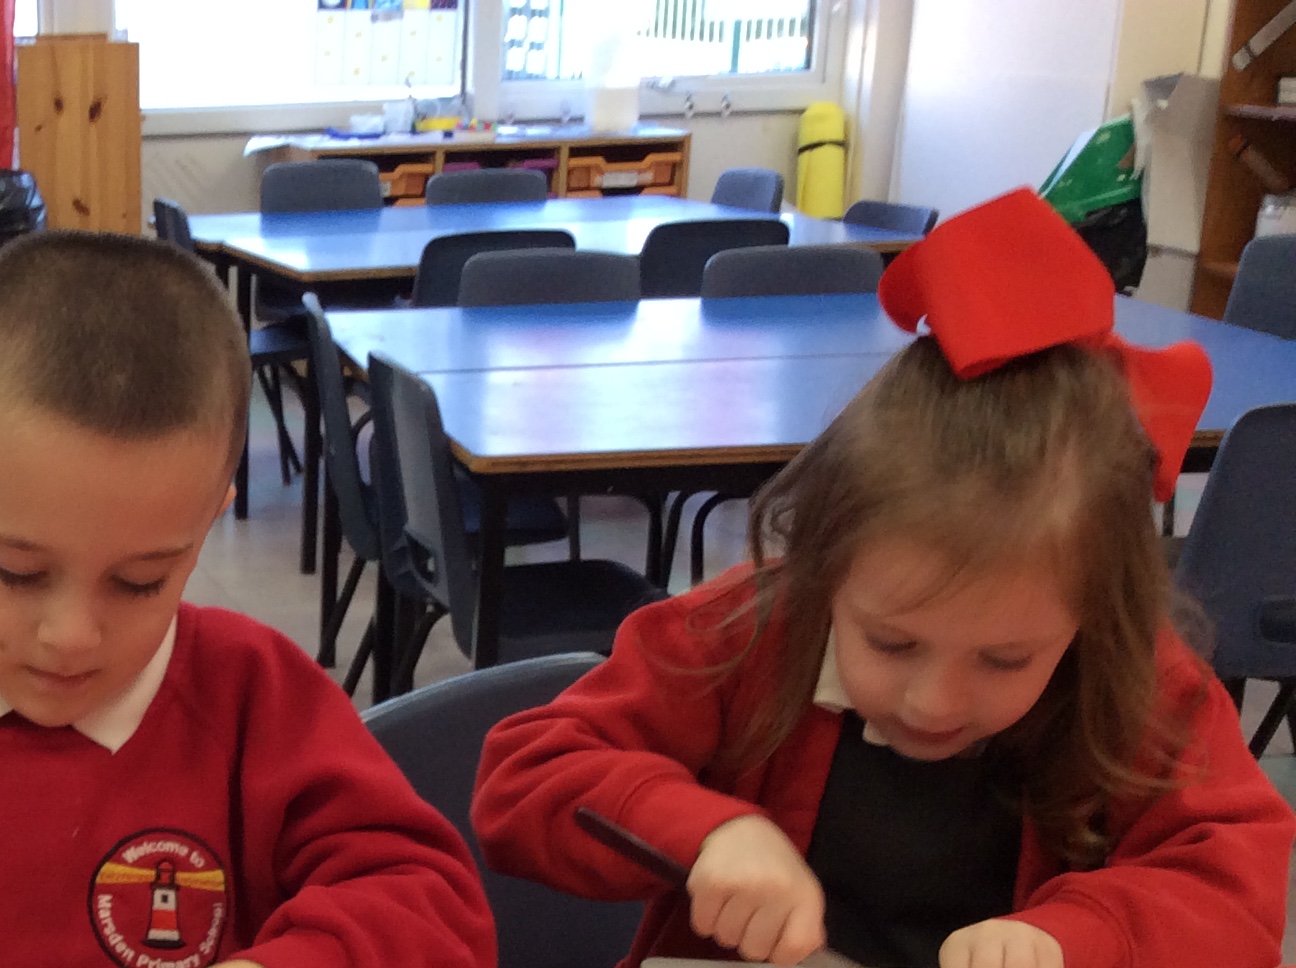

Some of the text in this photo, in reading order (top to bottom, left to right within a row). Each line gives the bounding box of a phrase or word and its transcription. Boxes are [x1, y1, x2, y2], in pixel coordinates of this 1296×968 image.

[121, 840, 205, 868] Welcome to
[97, 894, 136, 962] Marsden
